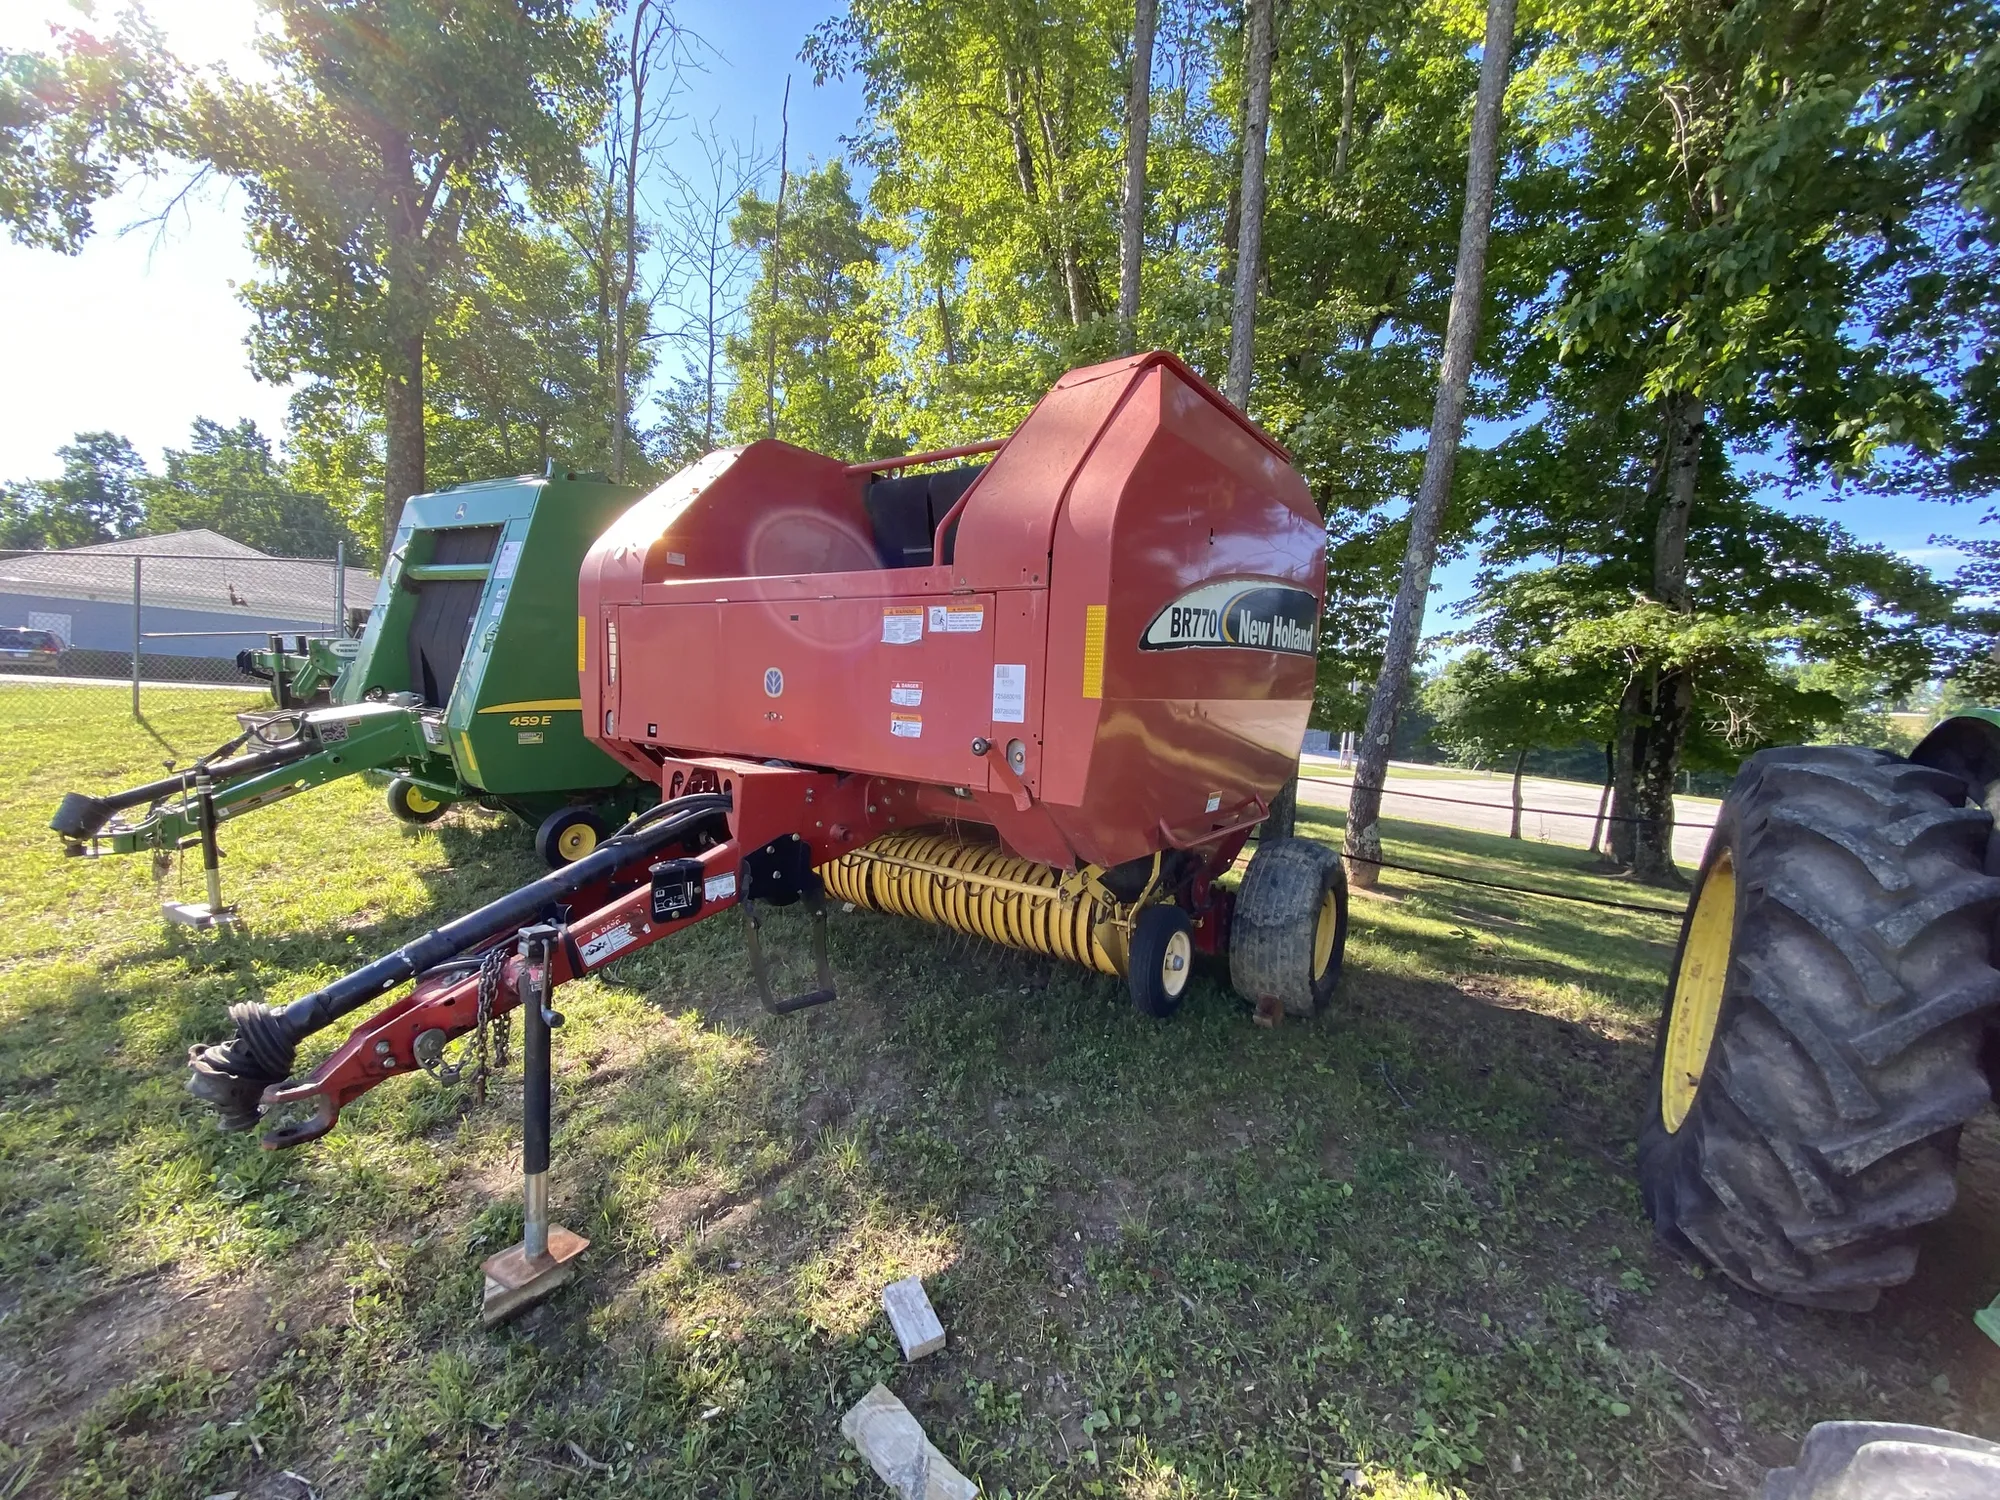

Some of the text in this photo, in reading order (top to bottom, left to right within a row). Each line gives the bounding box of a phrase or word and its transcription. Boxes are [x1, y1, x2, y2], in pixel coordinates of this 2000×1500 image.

[1170, 607, 1218, 639] BR770
[1238, 609, 1314, 652] New Holland
[510, 715, 552, 727] 459 E
